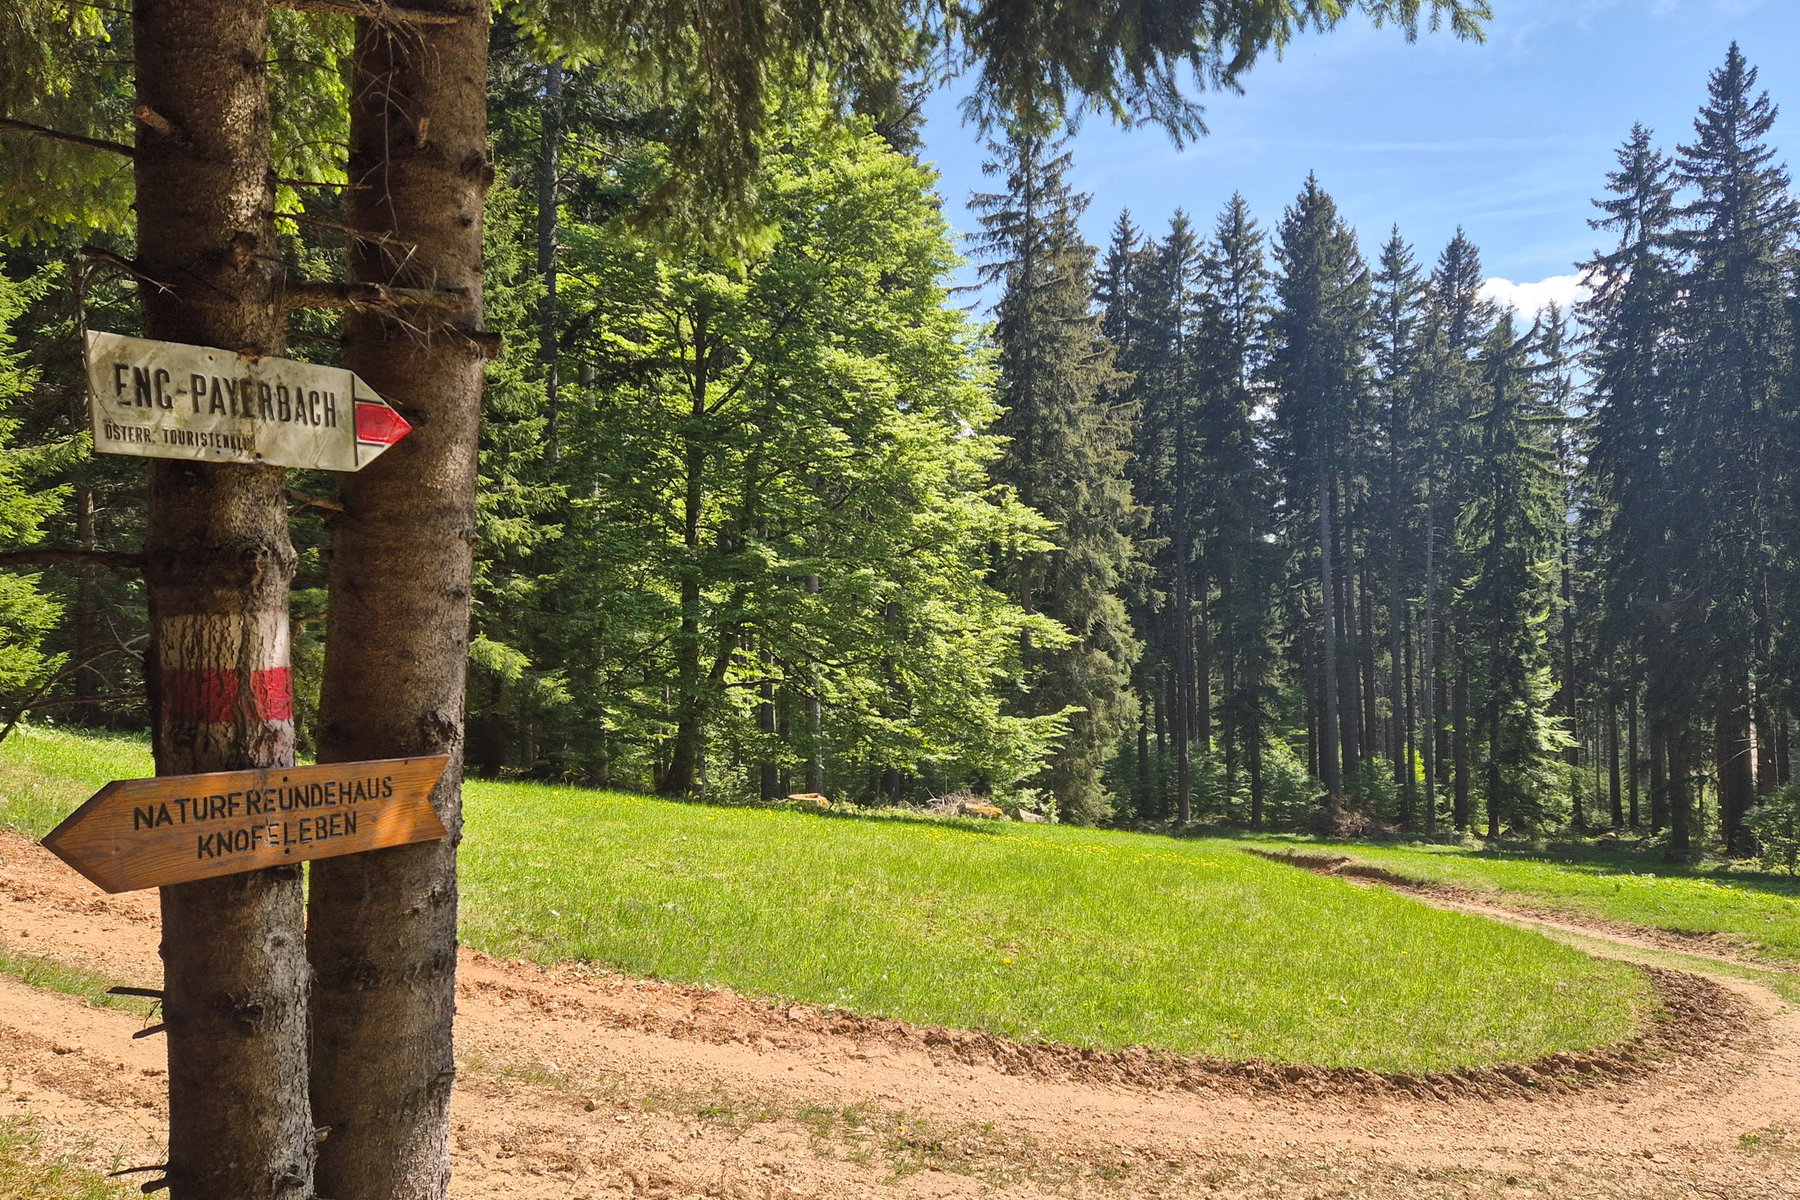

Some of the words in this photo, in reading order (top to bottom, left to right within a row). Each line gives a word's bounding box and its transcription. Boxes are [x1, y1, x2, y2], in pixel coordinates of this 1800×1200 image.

[115, 363, 337, 428] ENG-PAYERBACH
[104, 420, 156, 444] ÖSTERR.
[133, 776, 394, 831] NATURFREUNDEHAUS
[196, 811, 357, 860] KNOFELEBEN
